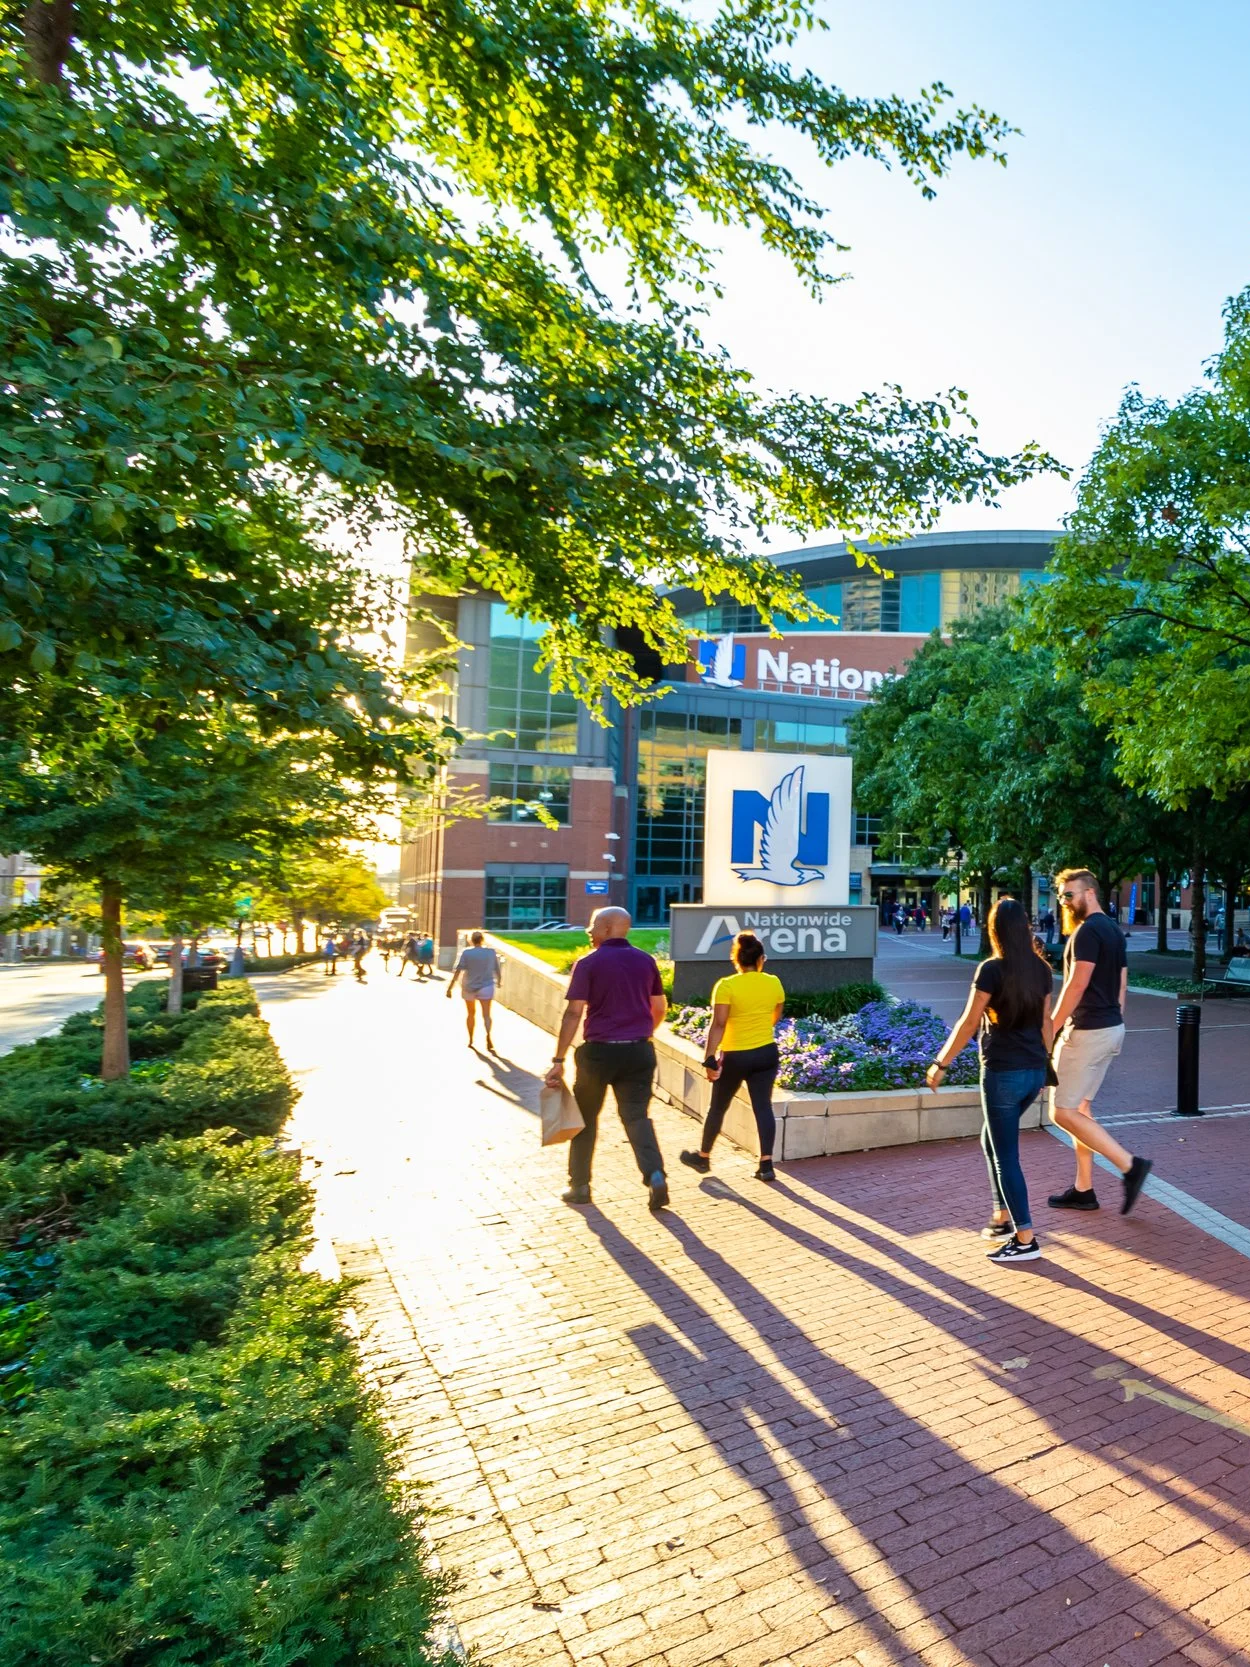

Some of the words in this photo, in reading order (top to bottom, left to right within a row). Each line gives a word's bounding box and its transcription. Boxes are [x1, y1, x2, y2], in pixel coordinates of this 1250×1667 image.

[757, 648, 904, 691] Nation
[694, 915, 848, 955] Arena
[744, 911, 852, 927] Nationwide
